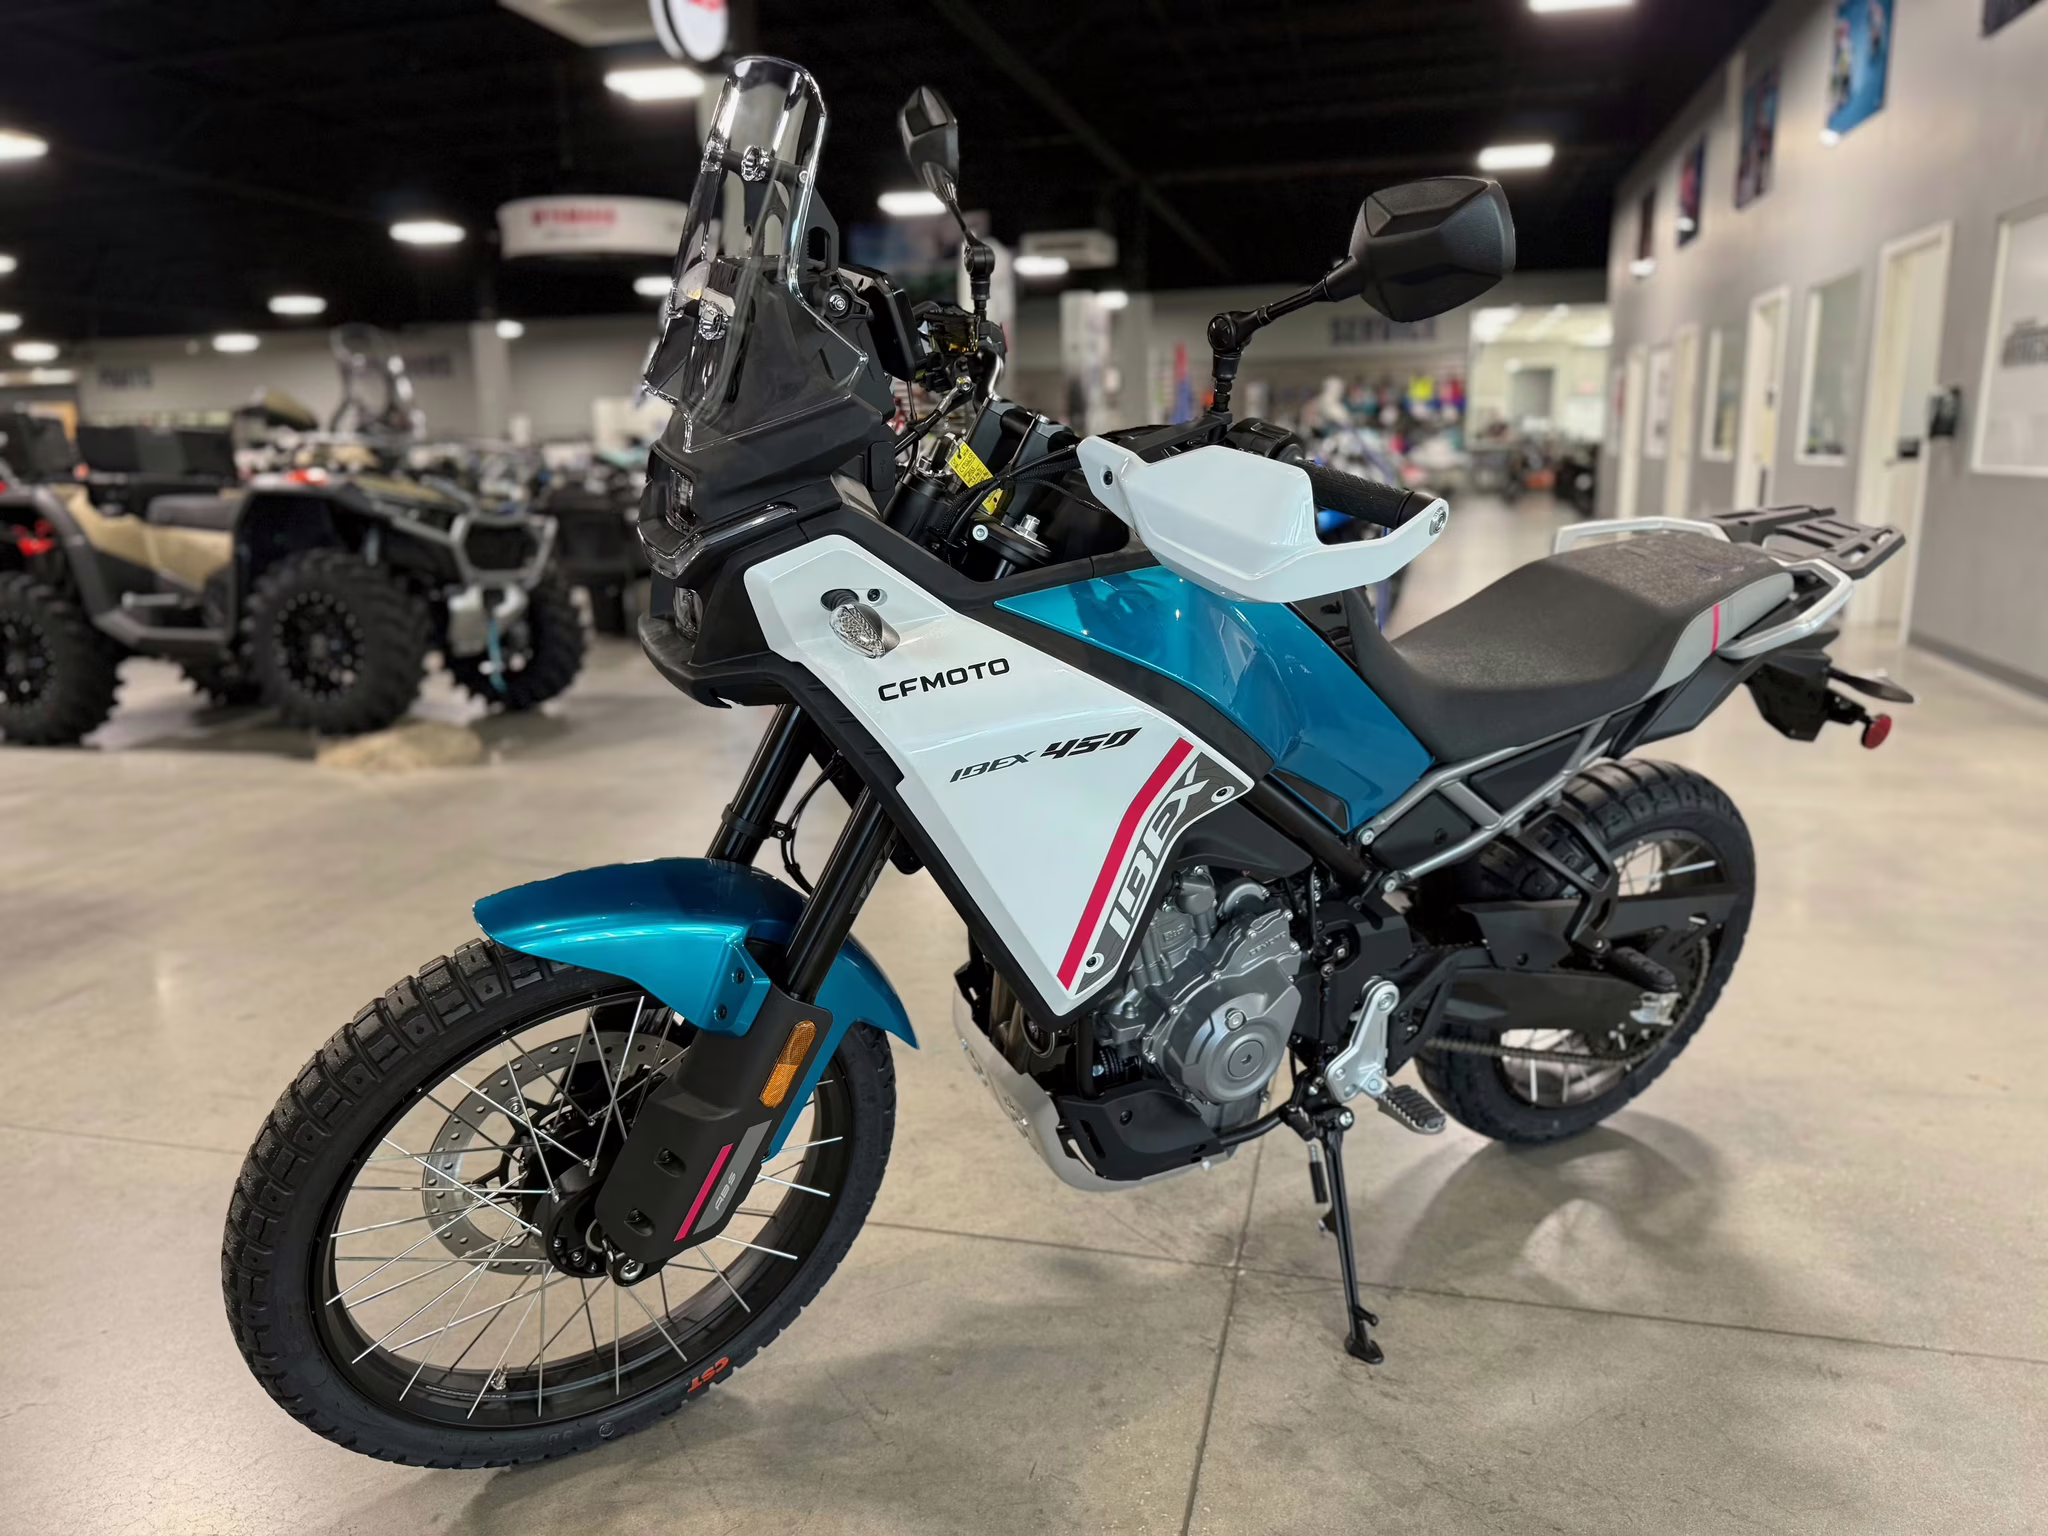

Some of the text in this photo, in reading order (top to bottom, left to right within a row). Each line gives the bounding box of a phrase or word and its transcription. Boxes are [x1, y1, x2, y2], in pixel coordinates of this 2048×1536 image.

[877, 657, 1010, 702] CFMOTO
[950, 727, 1143, 783] IBEX 450
[1106, 762, 1209, 941] IBEX
[715, 1172, 736, 1210] ABS
[687, 1357, 729, 1392] CST
